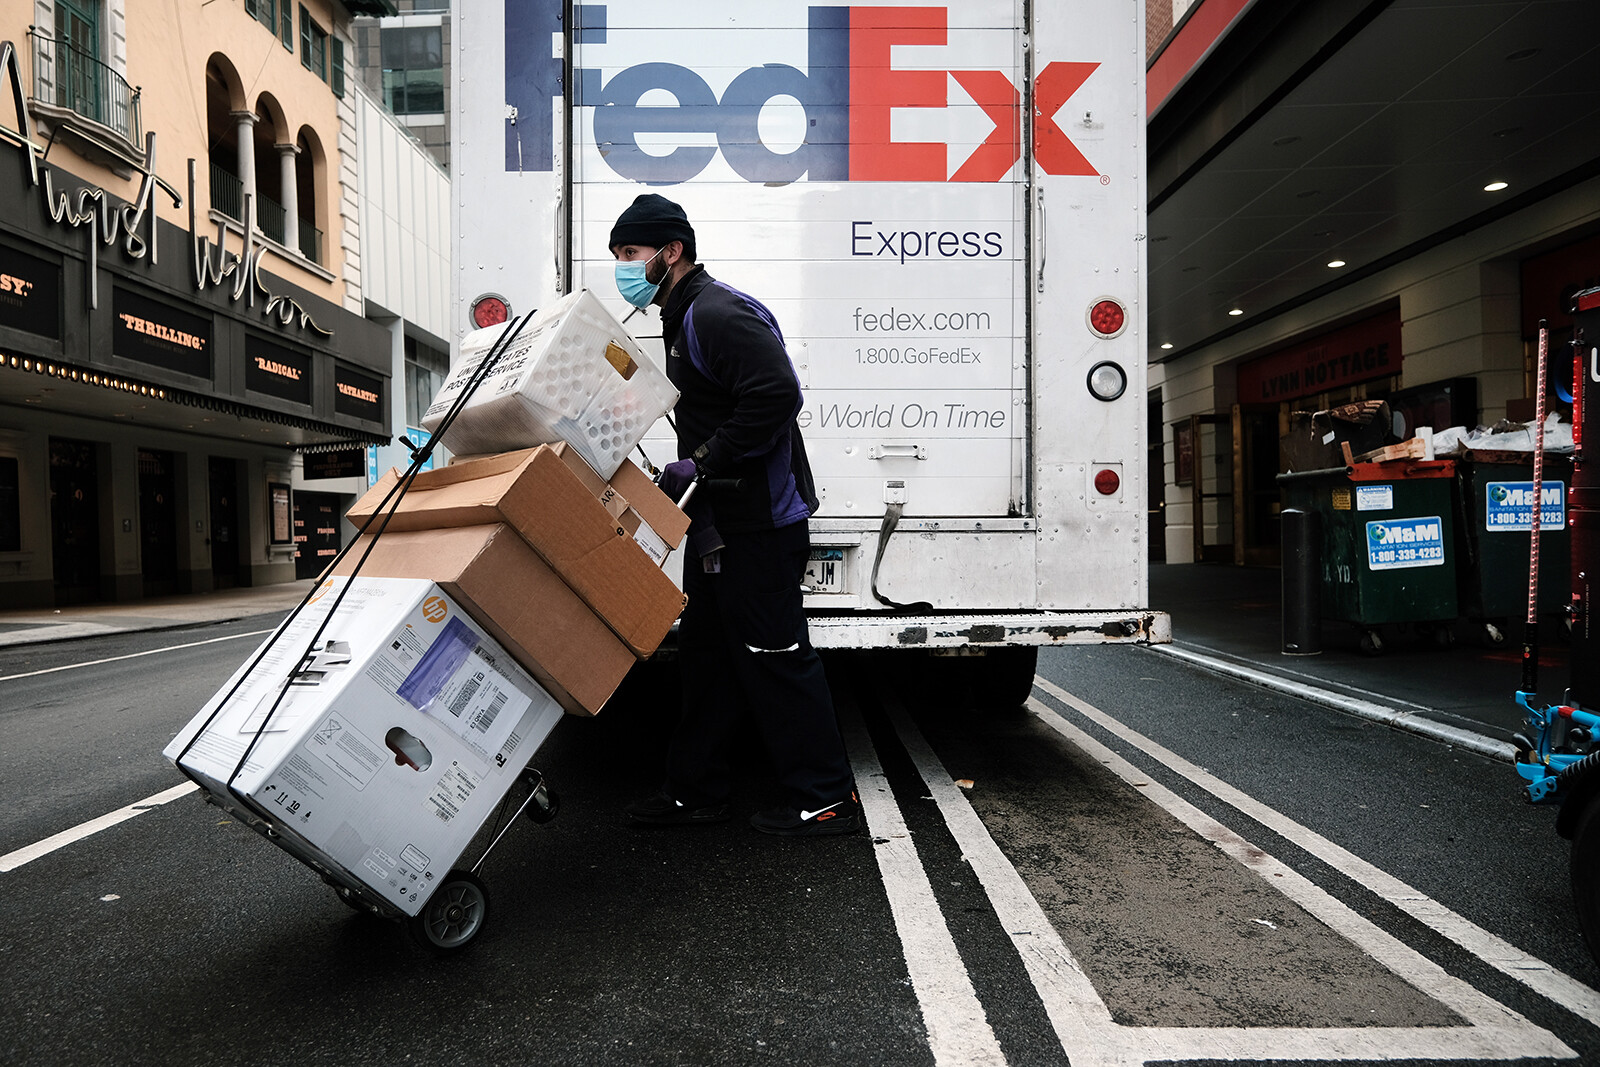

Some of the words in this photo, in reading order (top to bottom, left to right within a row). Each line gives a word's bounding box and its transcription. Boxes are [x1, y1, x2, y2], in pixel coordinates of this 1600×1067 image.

[505, 0, 1103, 187] FedEx
[187, 158, 334, 335] Wilson
[852, 221, 1003, 264] Express
[0, 273, 33, 297] SY."
[853, 307, 991, 331] fedex.com
[119, 313, 206, 350] "THRILLING."
[457, 359, 495, 379] UNITD
[494, 345, 532, 367] STATES
[855, 347, 982, 364] 1.800.GoFedEx
[444, 371, 484, 393] POSTL
[485, 357, 528, 380] SERVICE
[1262, 371, 1299, 398] LYNN
[1305, 342, 1389, 387] NOTTAGE
[798, 410, 812, 429] e
[819, 403, 893, 429] World
[901, 403, 938, 429] On
[944, 403, 1006, 429] Time
[1500, 488, 1561, 506] M&M
[1489, 512, 1562, 524] 1-800-334283
[1380, 524, 1439, 544] M&M
[1409, 541, 1441, 549] SERVICES
[1371, 547, 1441, 563] 1-800-339-4283
[816, 562, 835, 585] JM
[423, 596, 448, 623] hp
[495, 753, 508, 768] Fe
[290, 800, 301, 810] 10
